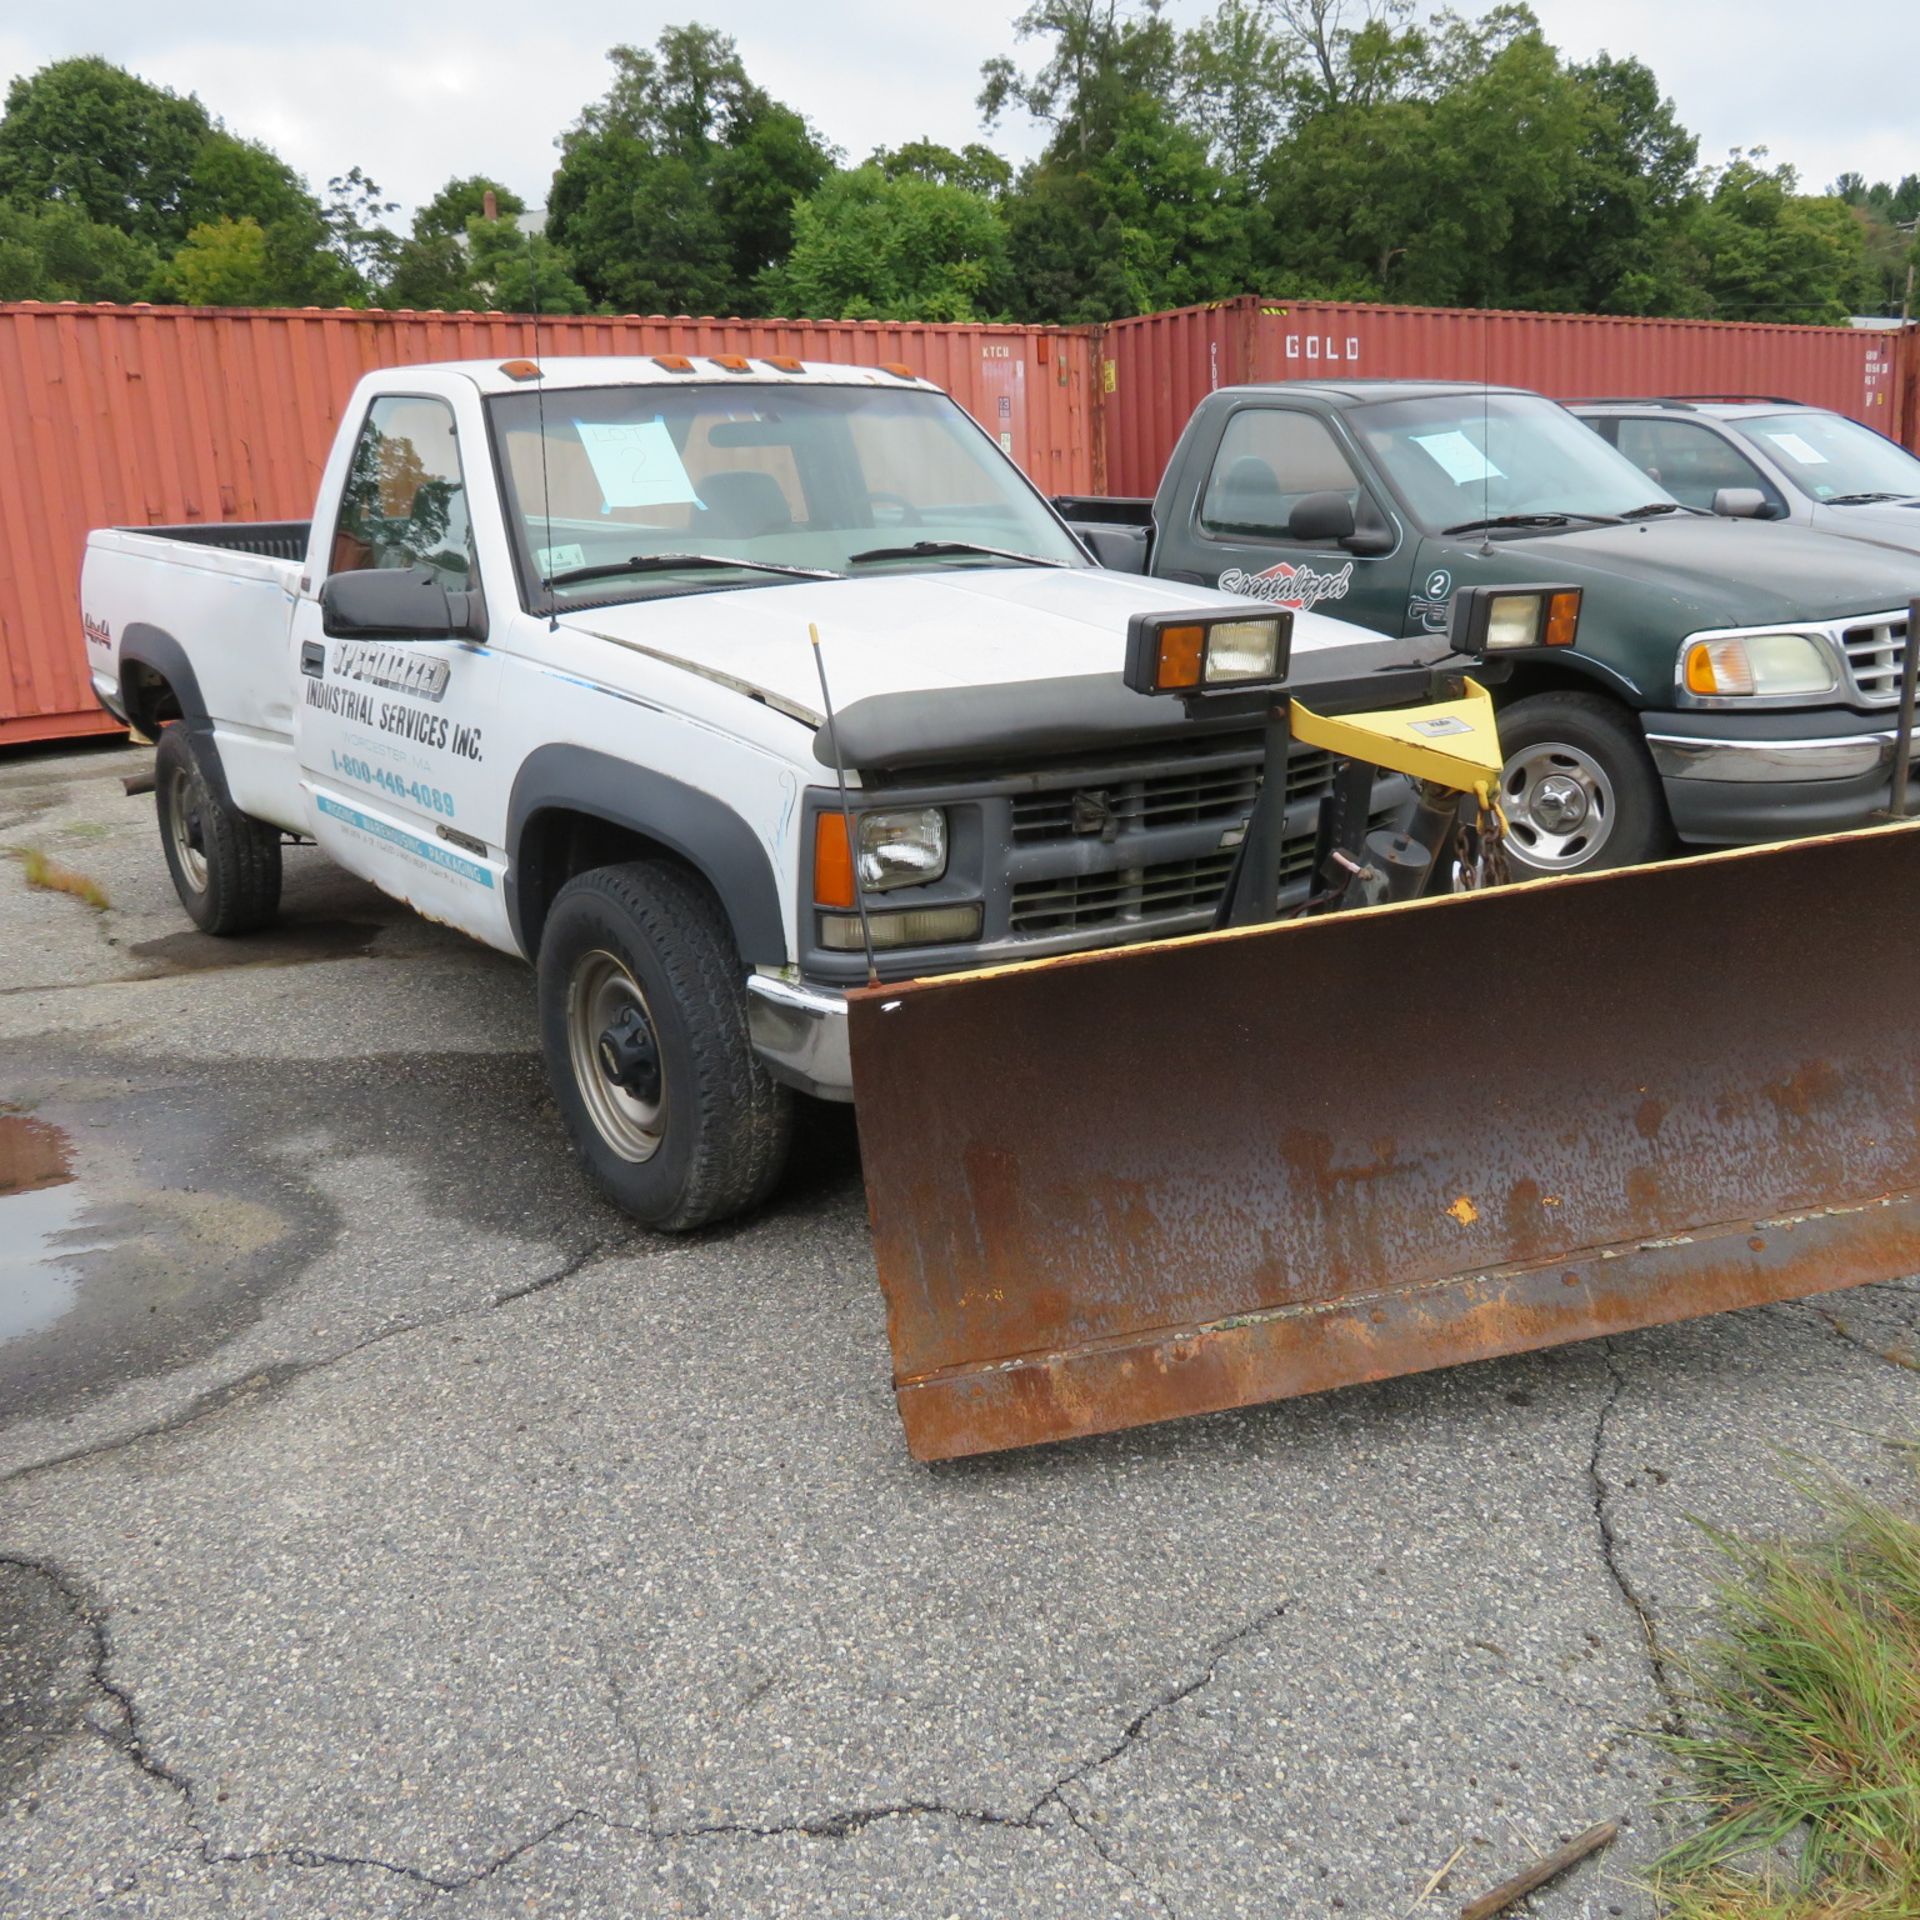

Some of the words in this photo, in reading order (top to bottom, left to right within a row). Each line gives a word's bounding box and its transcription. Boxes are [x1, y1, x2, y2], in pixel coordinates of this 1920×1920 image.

[982, 346, 1009, 358] KTCU
[1286, 335, 1358, 360] GOLD
[592, 426, 643, 442] LOT
[620, 446, 673, 483] 2
[1218, 562, 1354, 612] Specialized
[1430, 575, 1445, 594] 2
[332, 642, 451, 703] SPECIALIZED
[306, 678, 374, 727] INDUSTRIAL
[380, 702, 449, 750] SERVICES
[452, 723, 483, 762] INC.
